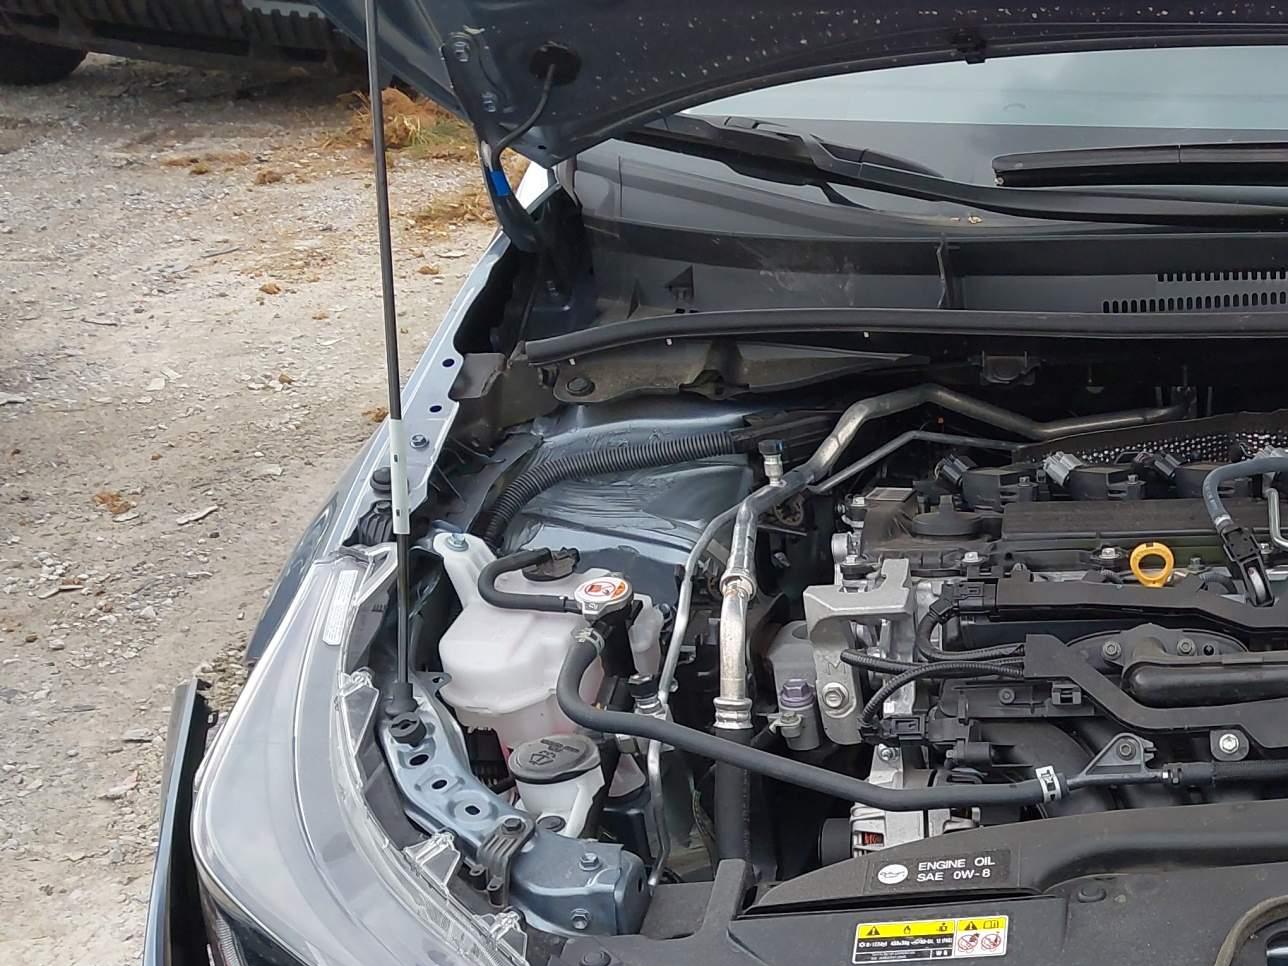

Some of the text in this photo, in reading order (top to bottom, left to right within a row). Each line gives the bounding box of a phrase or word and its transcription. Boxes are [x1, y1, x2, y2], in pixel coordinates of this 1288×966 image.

[918, 856, 996, 872] ENGINE OIL
[916, 872, 944, 882] SAE
